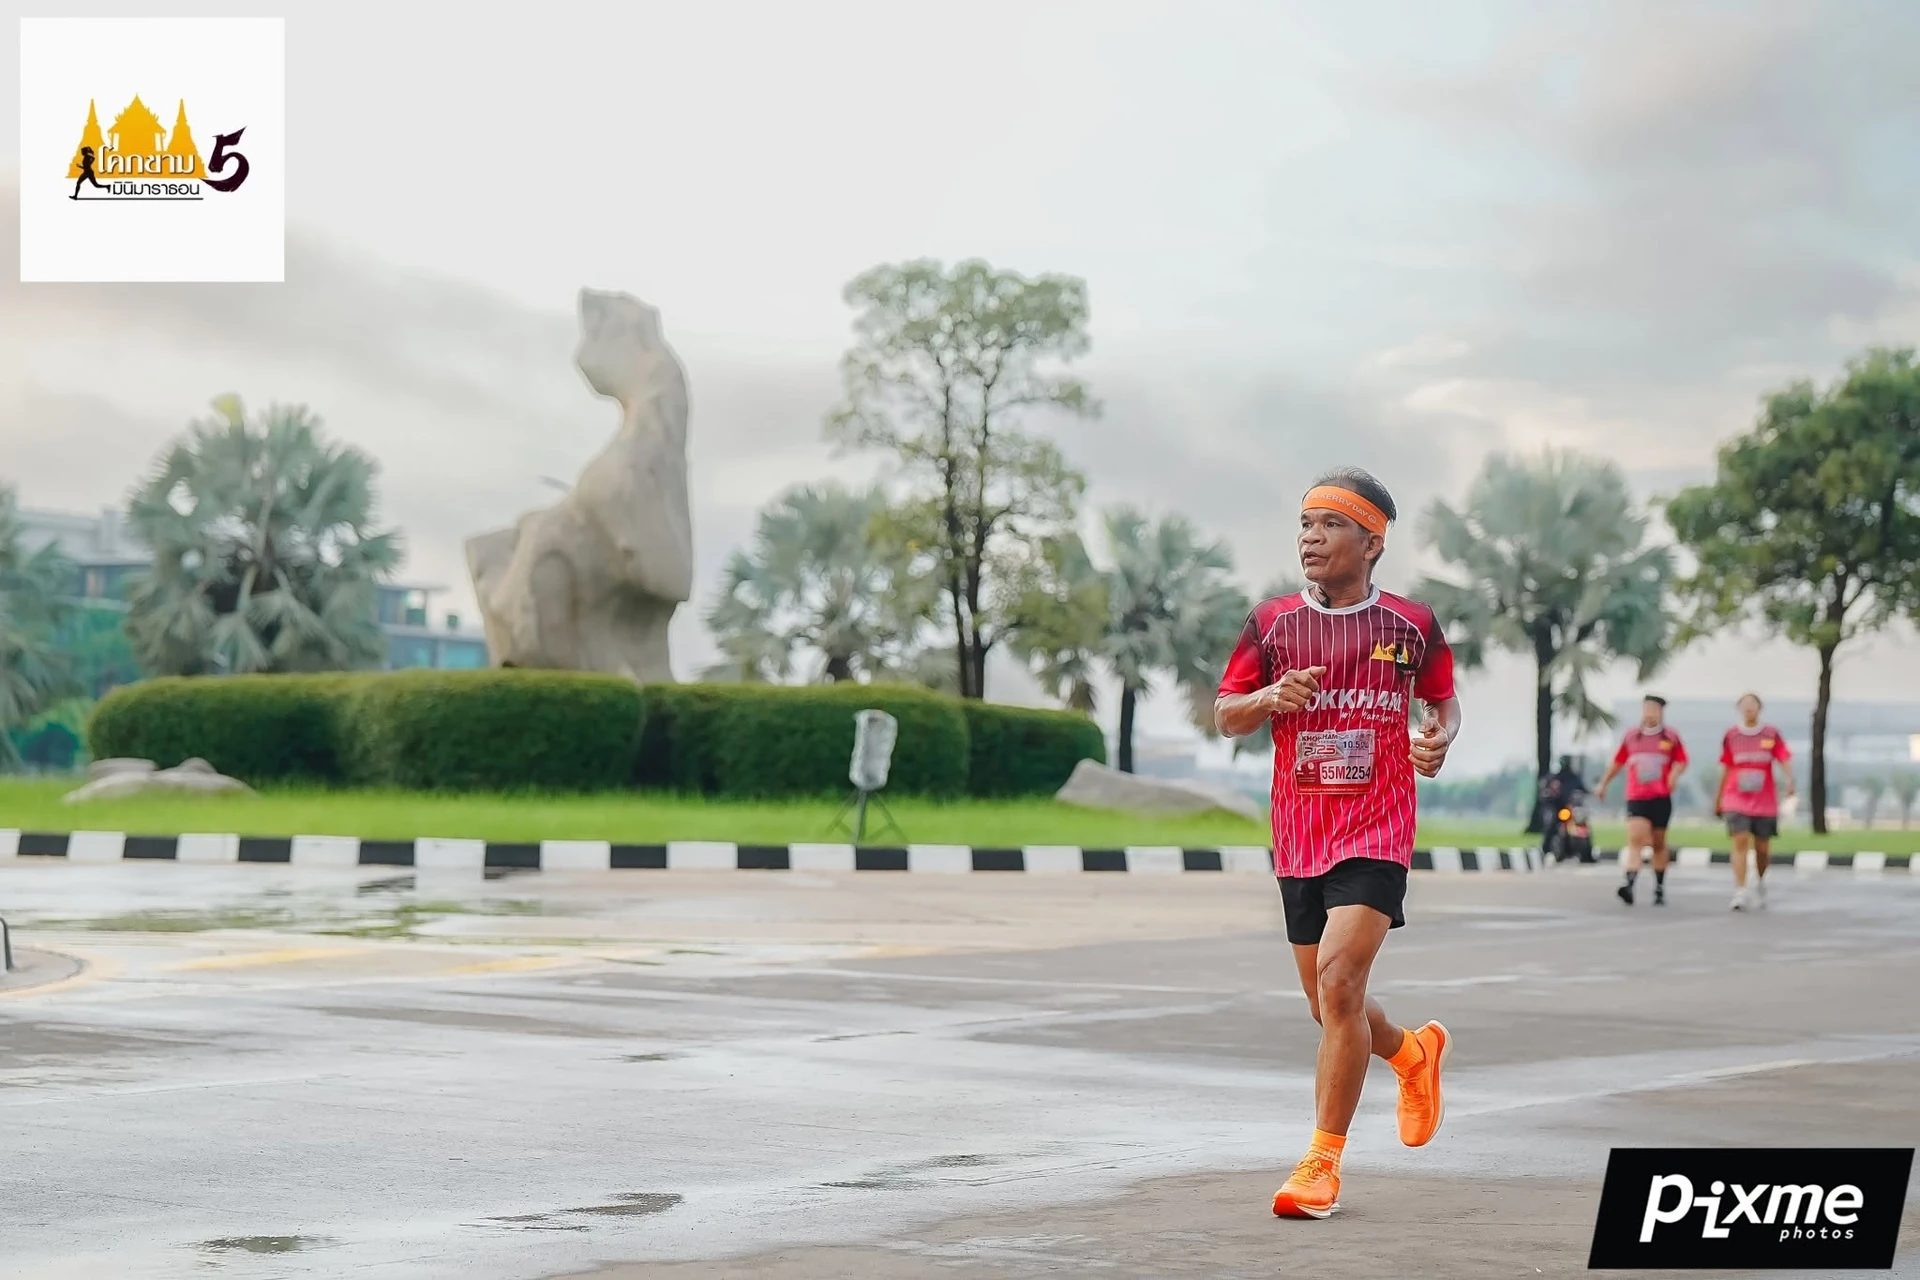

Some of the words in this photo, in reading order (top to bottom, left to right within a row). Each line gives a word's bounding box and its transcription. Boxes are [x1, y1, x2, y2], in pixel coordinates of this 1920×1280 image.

[1320, 492, 1352, 506] KERRY
[1352, 504, 1368, 517] DAY
[1322, 765, 1371, 780] 55M2254
